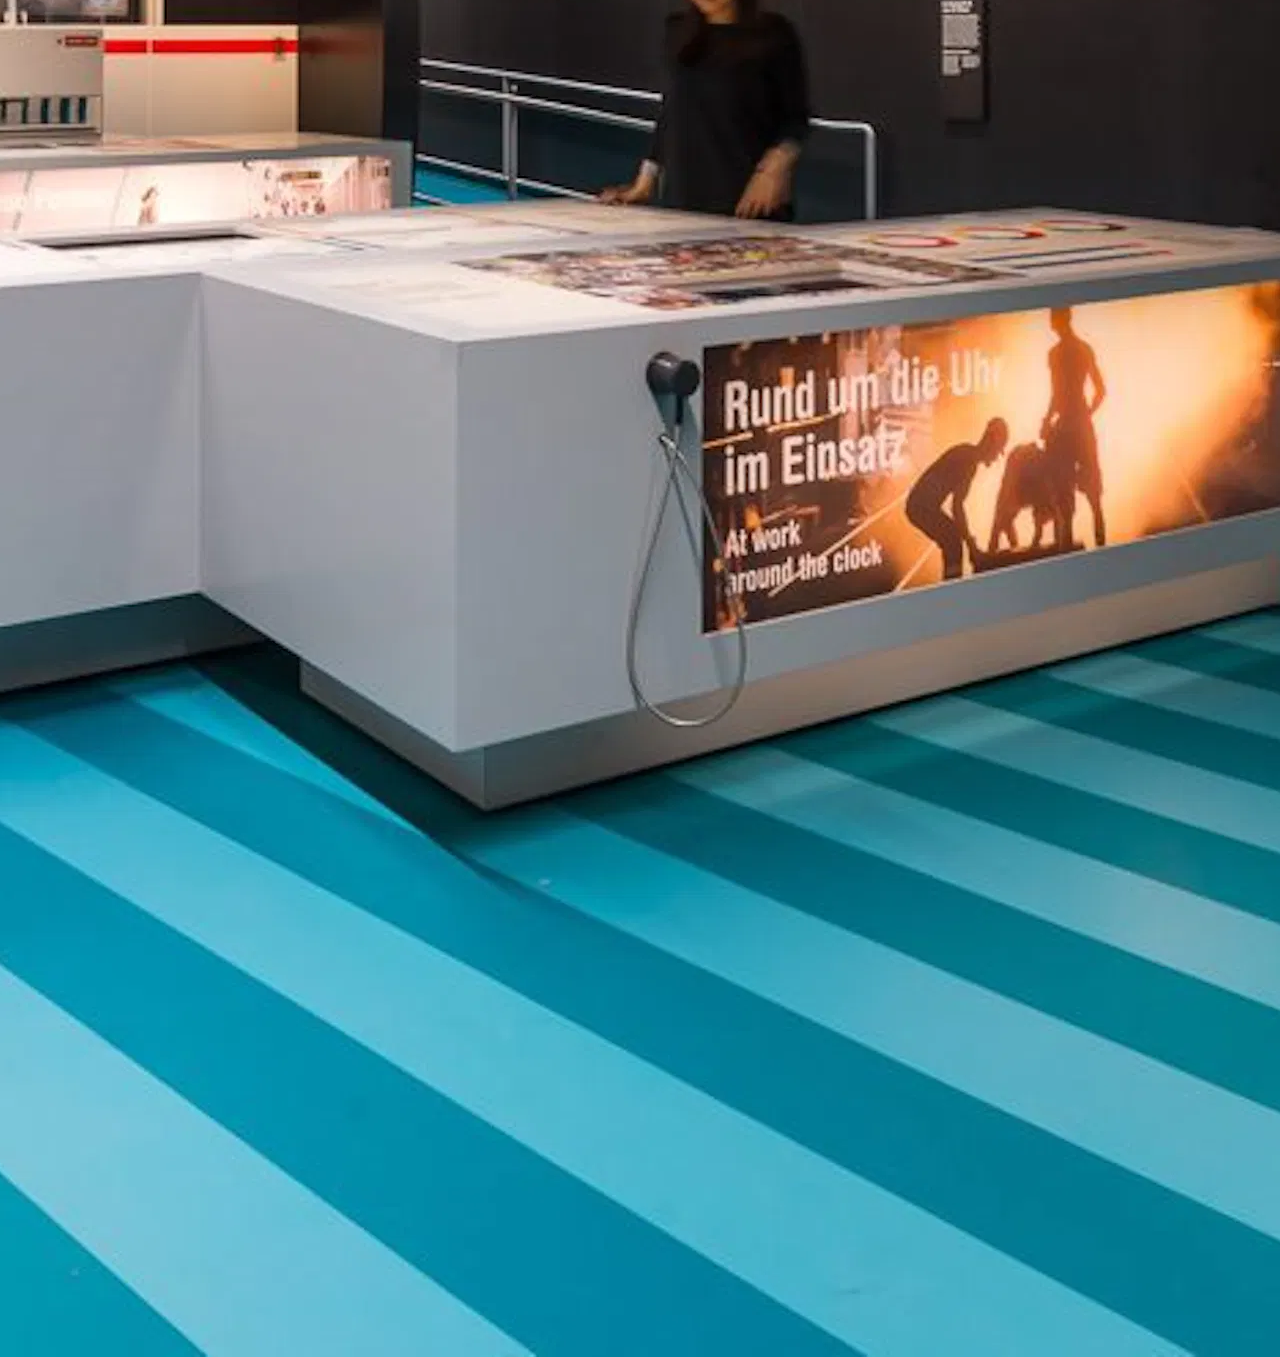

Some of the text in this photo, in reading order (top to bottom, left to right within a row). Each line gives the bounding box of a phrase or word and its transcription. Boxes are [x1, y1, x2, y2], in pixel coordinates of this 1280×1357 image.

[724, 349, 1002, 431] Rund um die Uhr
[725, 427, 906, 496] im Einsatz
[724, 518, 802, 560] At work
[724, 539, 883, 594] around the clock
